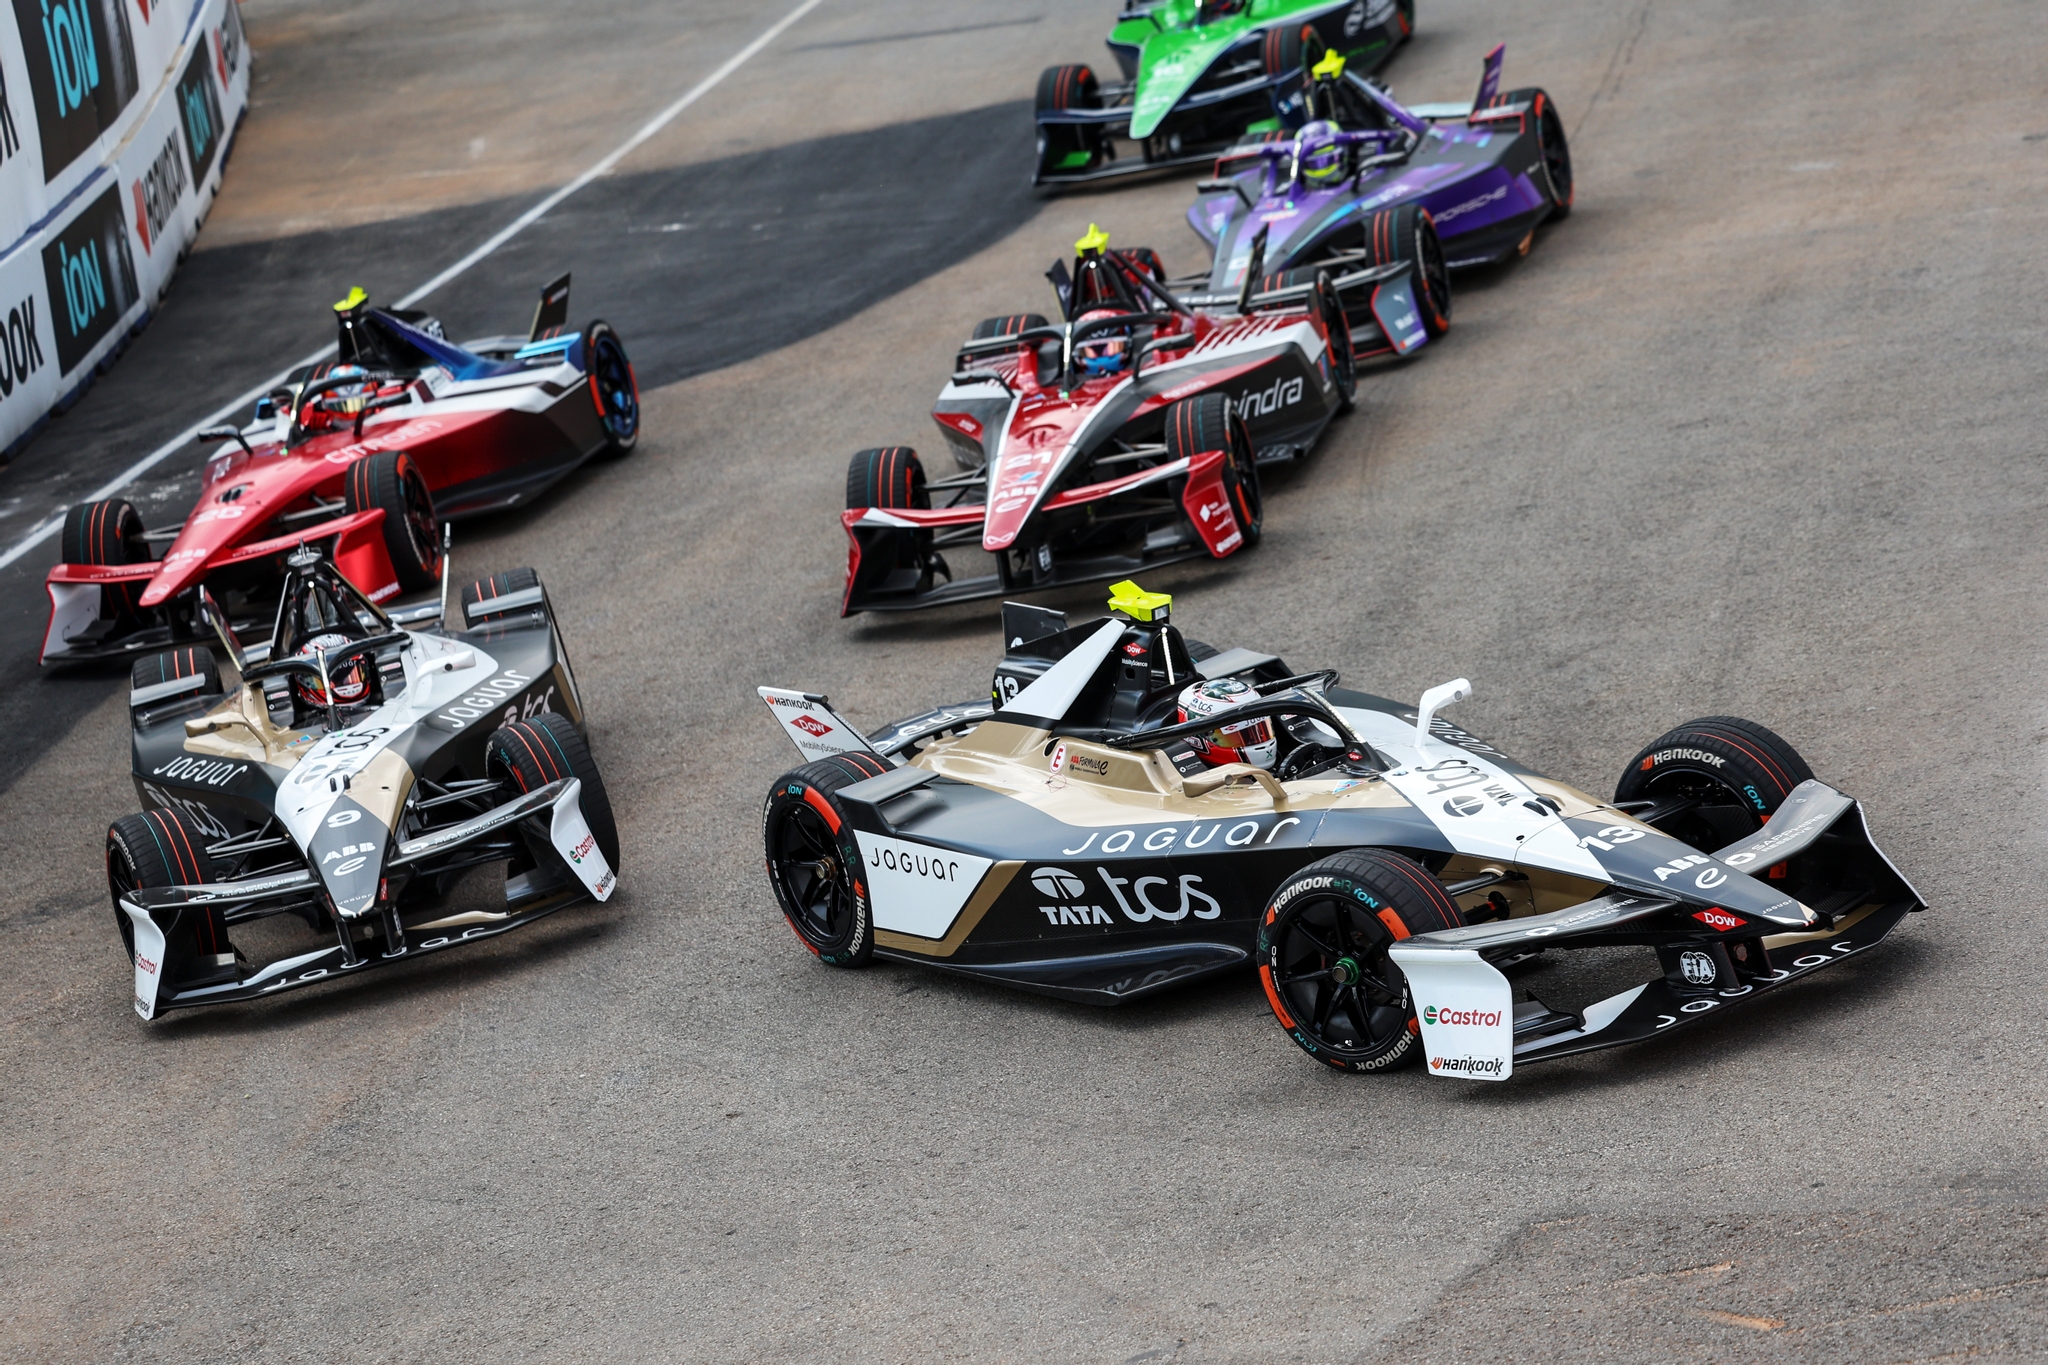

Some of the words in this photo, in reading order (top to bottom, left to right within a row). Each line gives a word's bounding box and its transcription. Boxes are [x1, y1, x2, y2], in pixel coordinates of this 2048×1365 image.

[1233, 376, 1303, 420] indra
[1053, 748, 1063, 768] E
[327, 810, 361, 828] 9
[1577, 825, 1646, 852] 13
[322, 842, 376, 864] ABB
[1653, 854, 1710, 881] ABB
[1097, 866, 1221, 923] tcs
[1039, 905, 1114, 925] TATA
[1704, 912, 1736, 927] Dow
[1439, 1007, 1502, 1027] Castrol
[1442, 1058, 1504, 1073] Hankook
